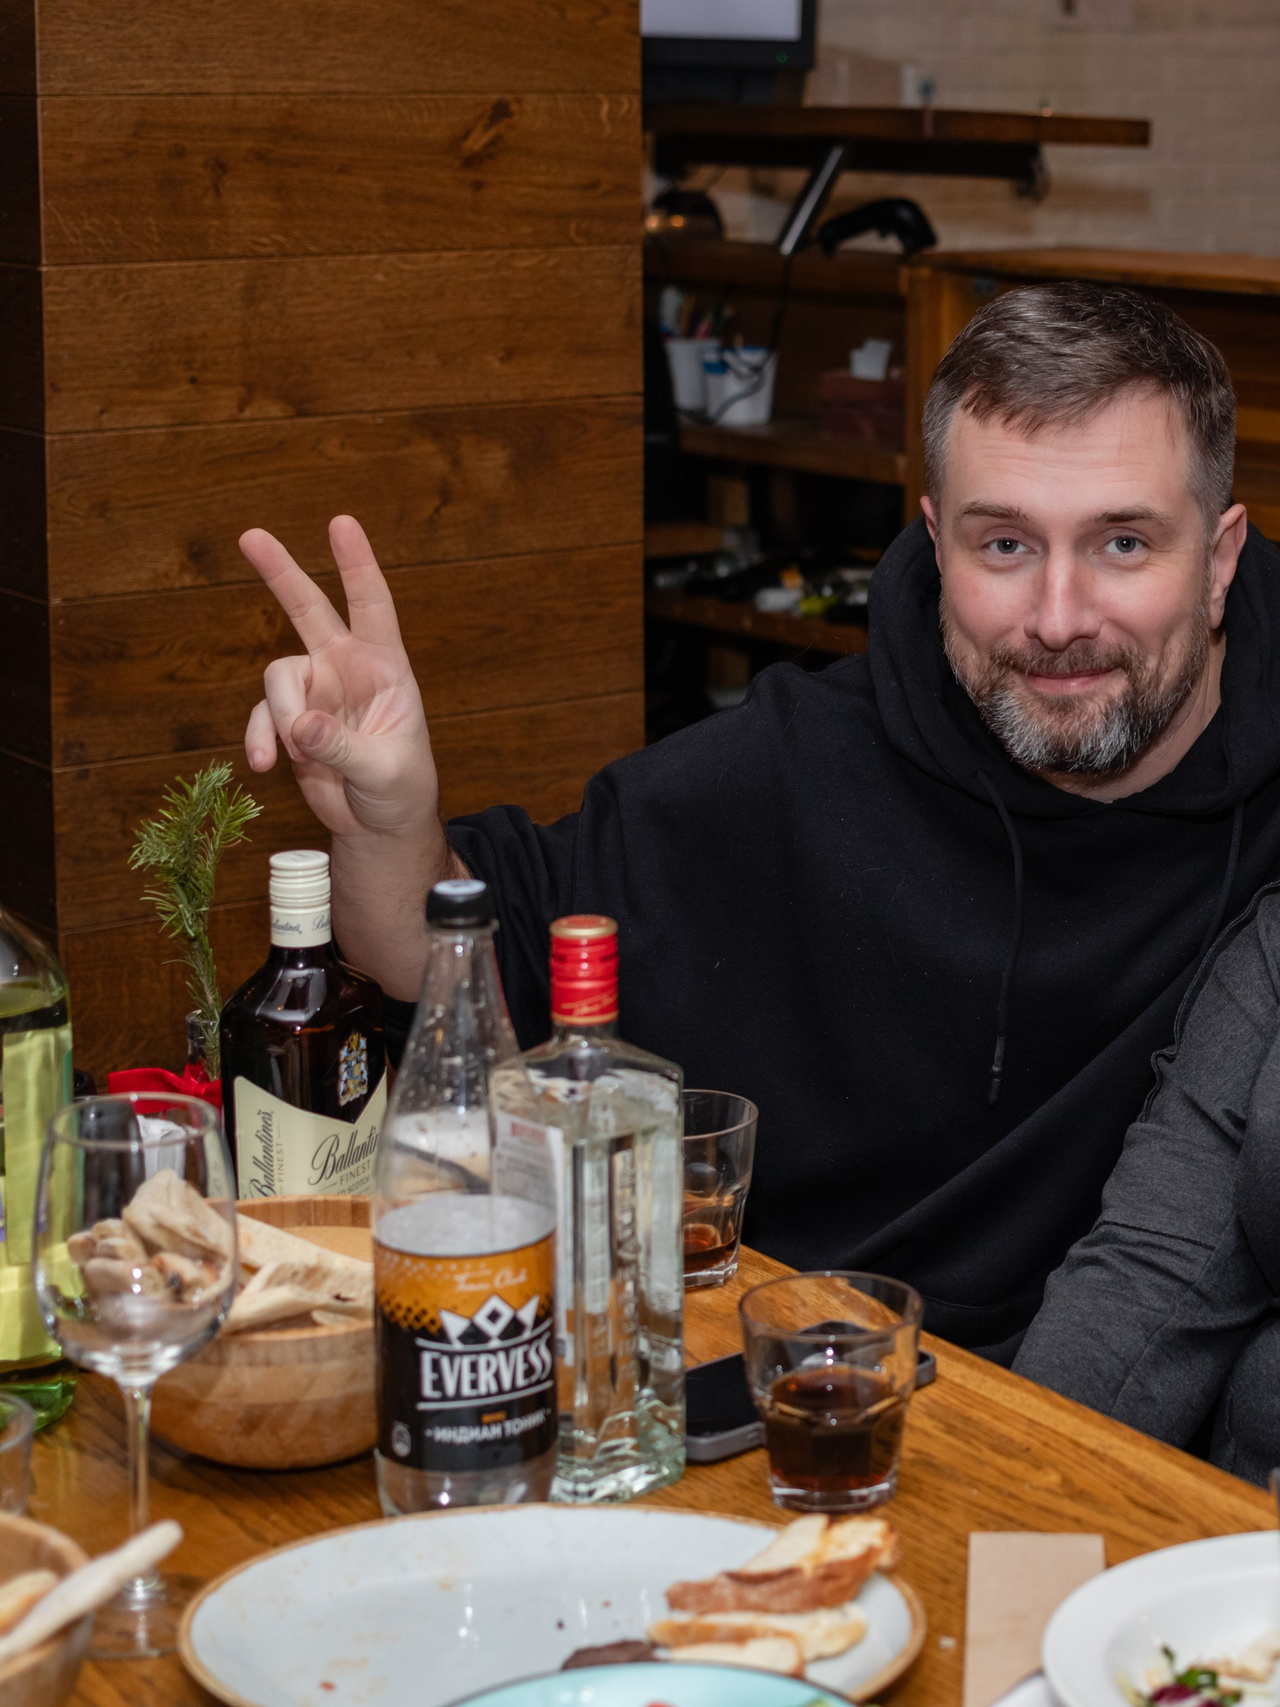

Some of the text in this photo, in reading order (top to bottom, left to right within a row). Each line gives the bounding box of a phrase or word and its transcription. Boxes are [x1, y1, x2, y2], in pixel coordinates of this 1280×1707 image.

[276, 1142, 284, 1183] FINEST
[340, 1159, 371, 1185] FINEST
[421, 1332, 552, 1398] EVERVESS
